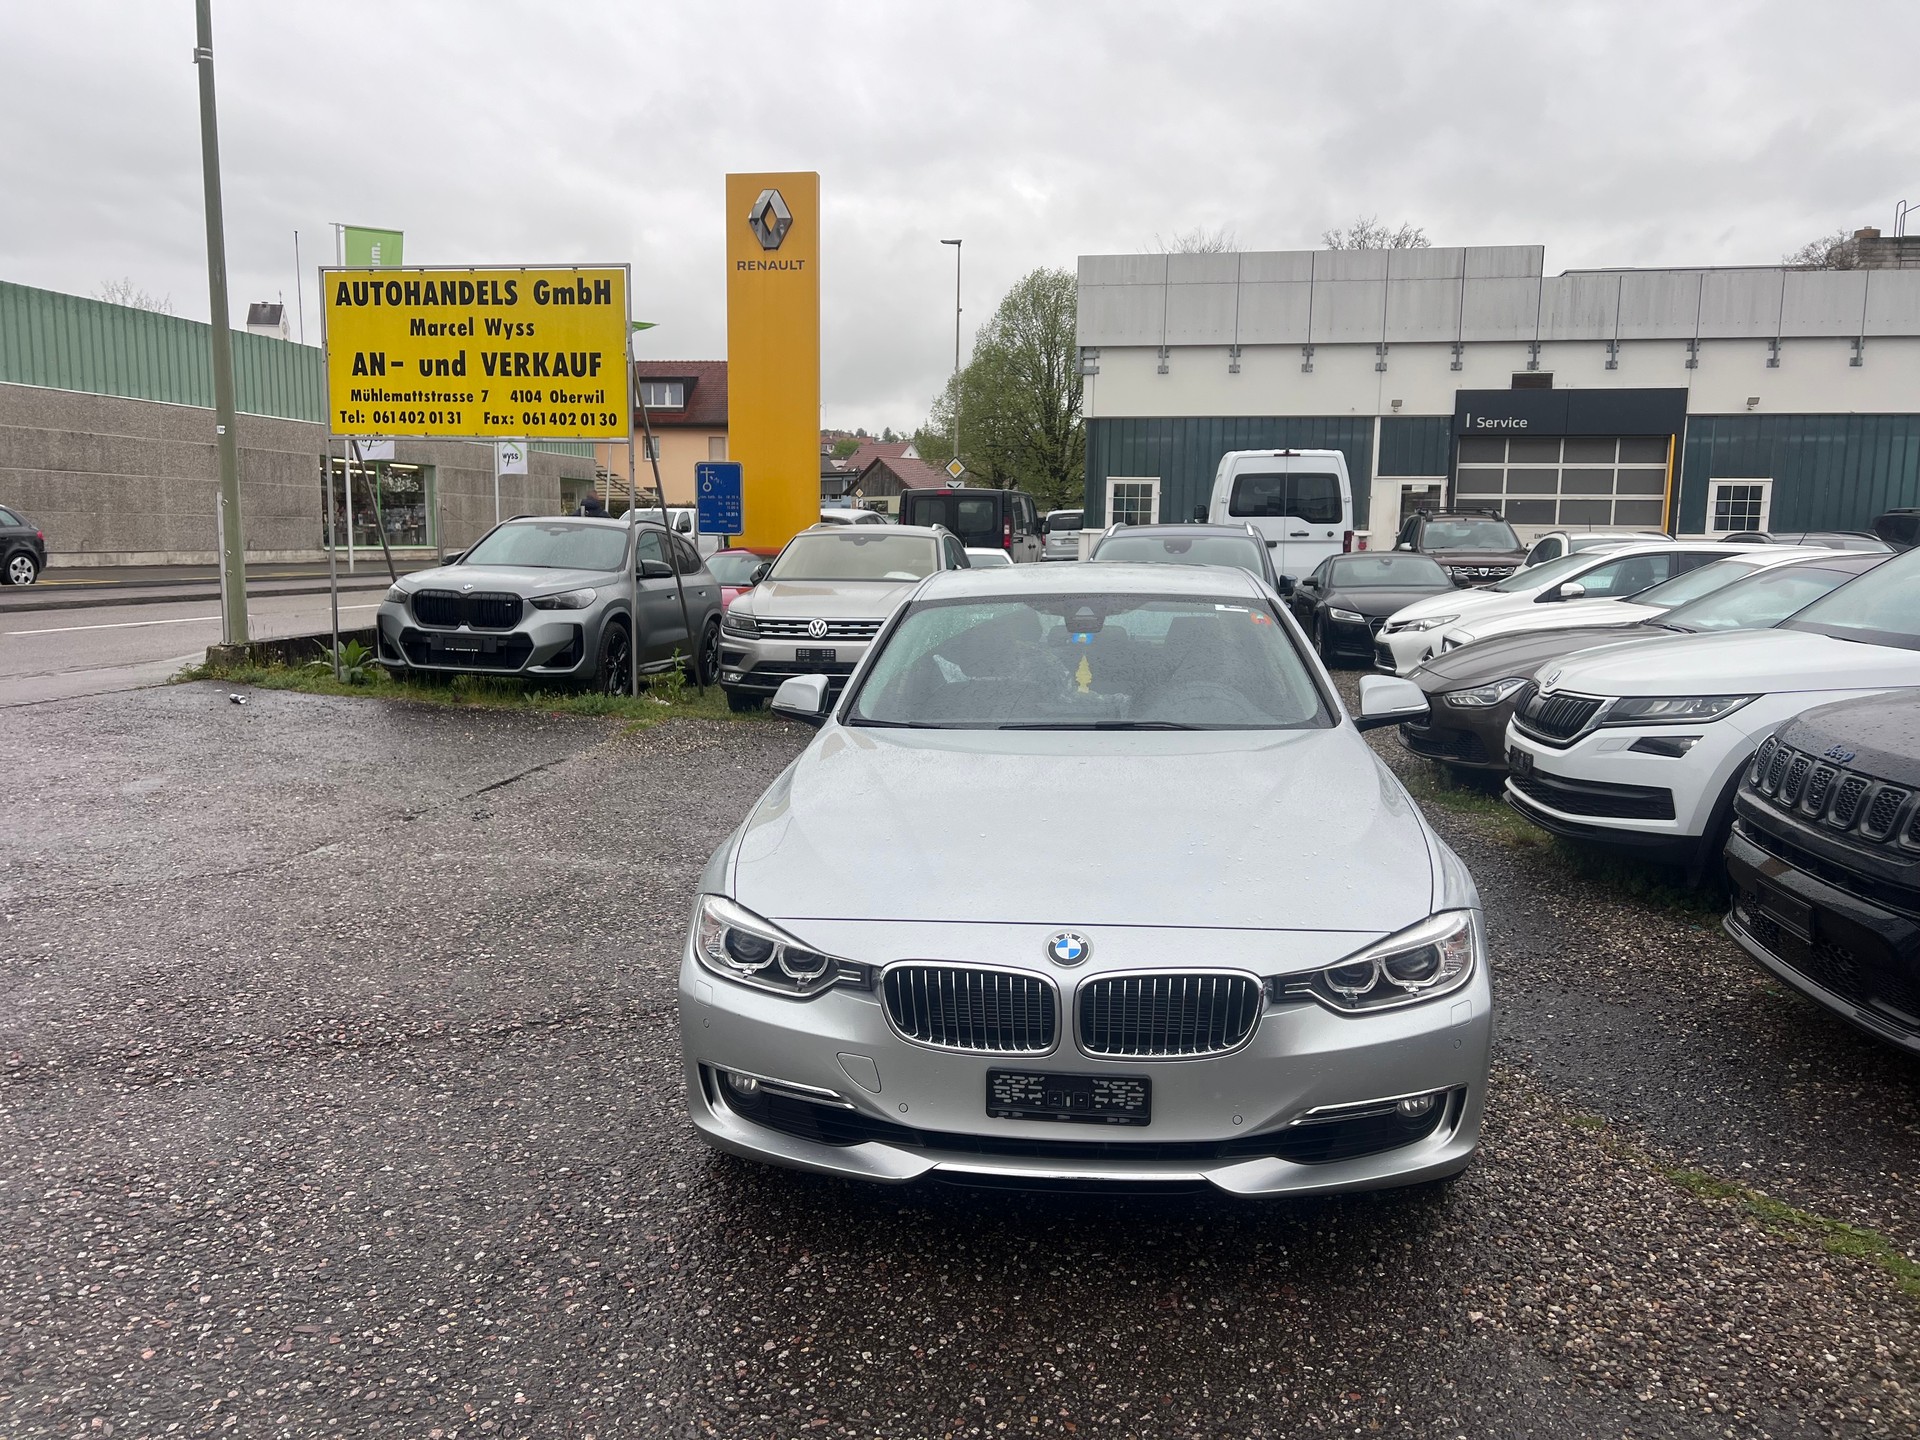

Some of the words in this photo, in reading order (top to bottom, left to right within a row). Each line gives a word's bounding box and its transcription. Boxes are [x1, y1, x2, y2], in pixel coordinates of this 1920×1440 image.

[737, 260, 805, 271] RENAULT
[335, 279, 518, 307] AUTOHANDELS
[533, 277, 611, 306] GmbH
[409, 316, 474, 337] Marcel
[484, 318, 535, 341] Wyss
[418, 349, 467, 377] und
[480, 351, 602, 378] VERKAUF
[350, 388, 474, 403] Mühlemattstrasse
[481, 389, 489, 403] 7
[510, 389, 542, 403] 4104
[549, 389, 605, 404] Oberwil
[339, 409, 365, 424] Tel:
[483, 411, 514, 425] Fax:
[1476, 416, 1528, 429] Service
